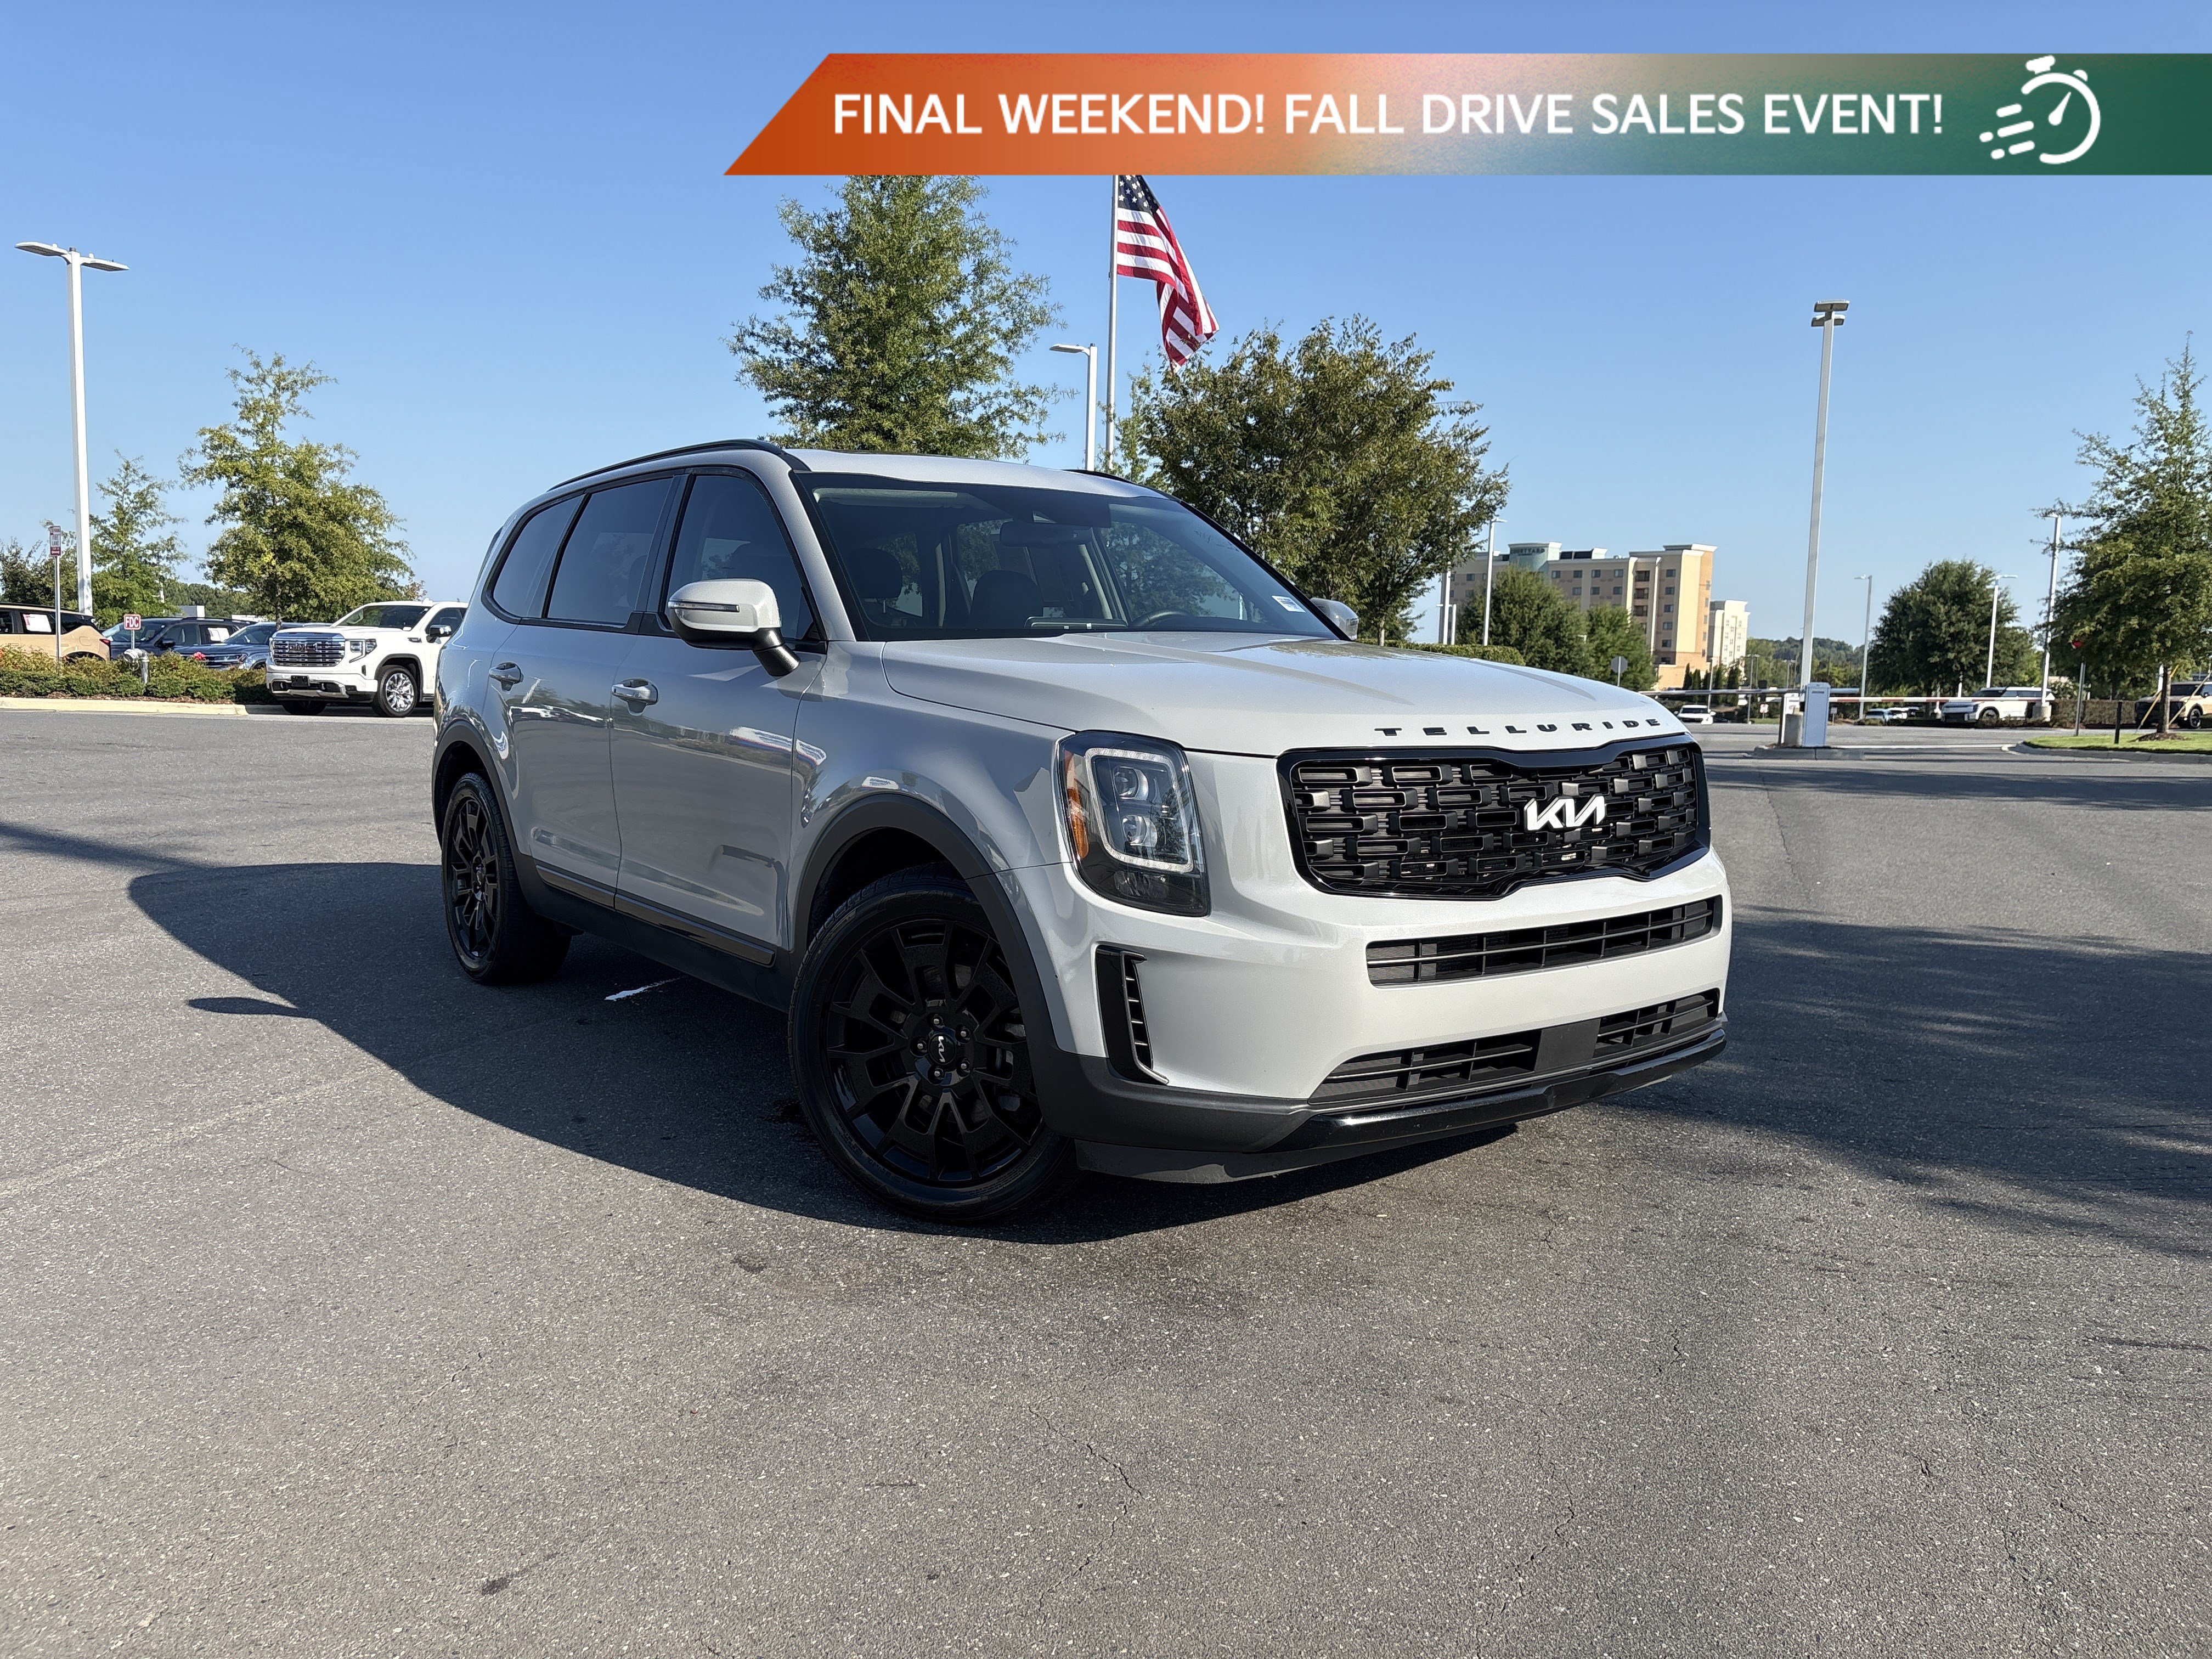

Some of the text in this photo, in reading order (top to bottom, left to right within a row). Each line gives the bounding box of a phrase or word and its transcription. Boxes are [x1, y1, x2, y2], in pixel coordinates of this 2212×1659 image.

[125, 616, 139, 628] FDC
[1374, 718, 1661, 736] TELLURIDE
[1525, 795, 1605, 831] KIA
